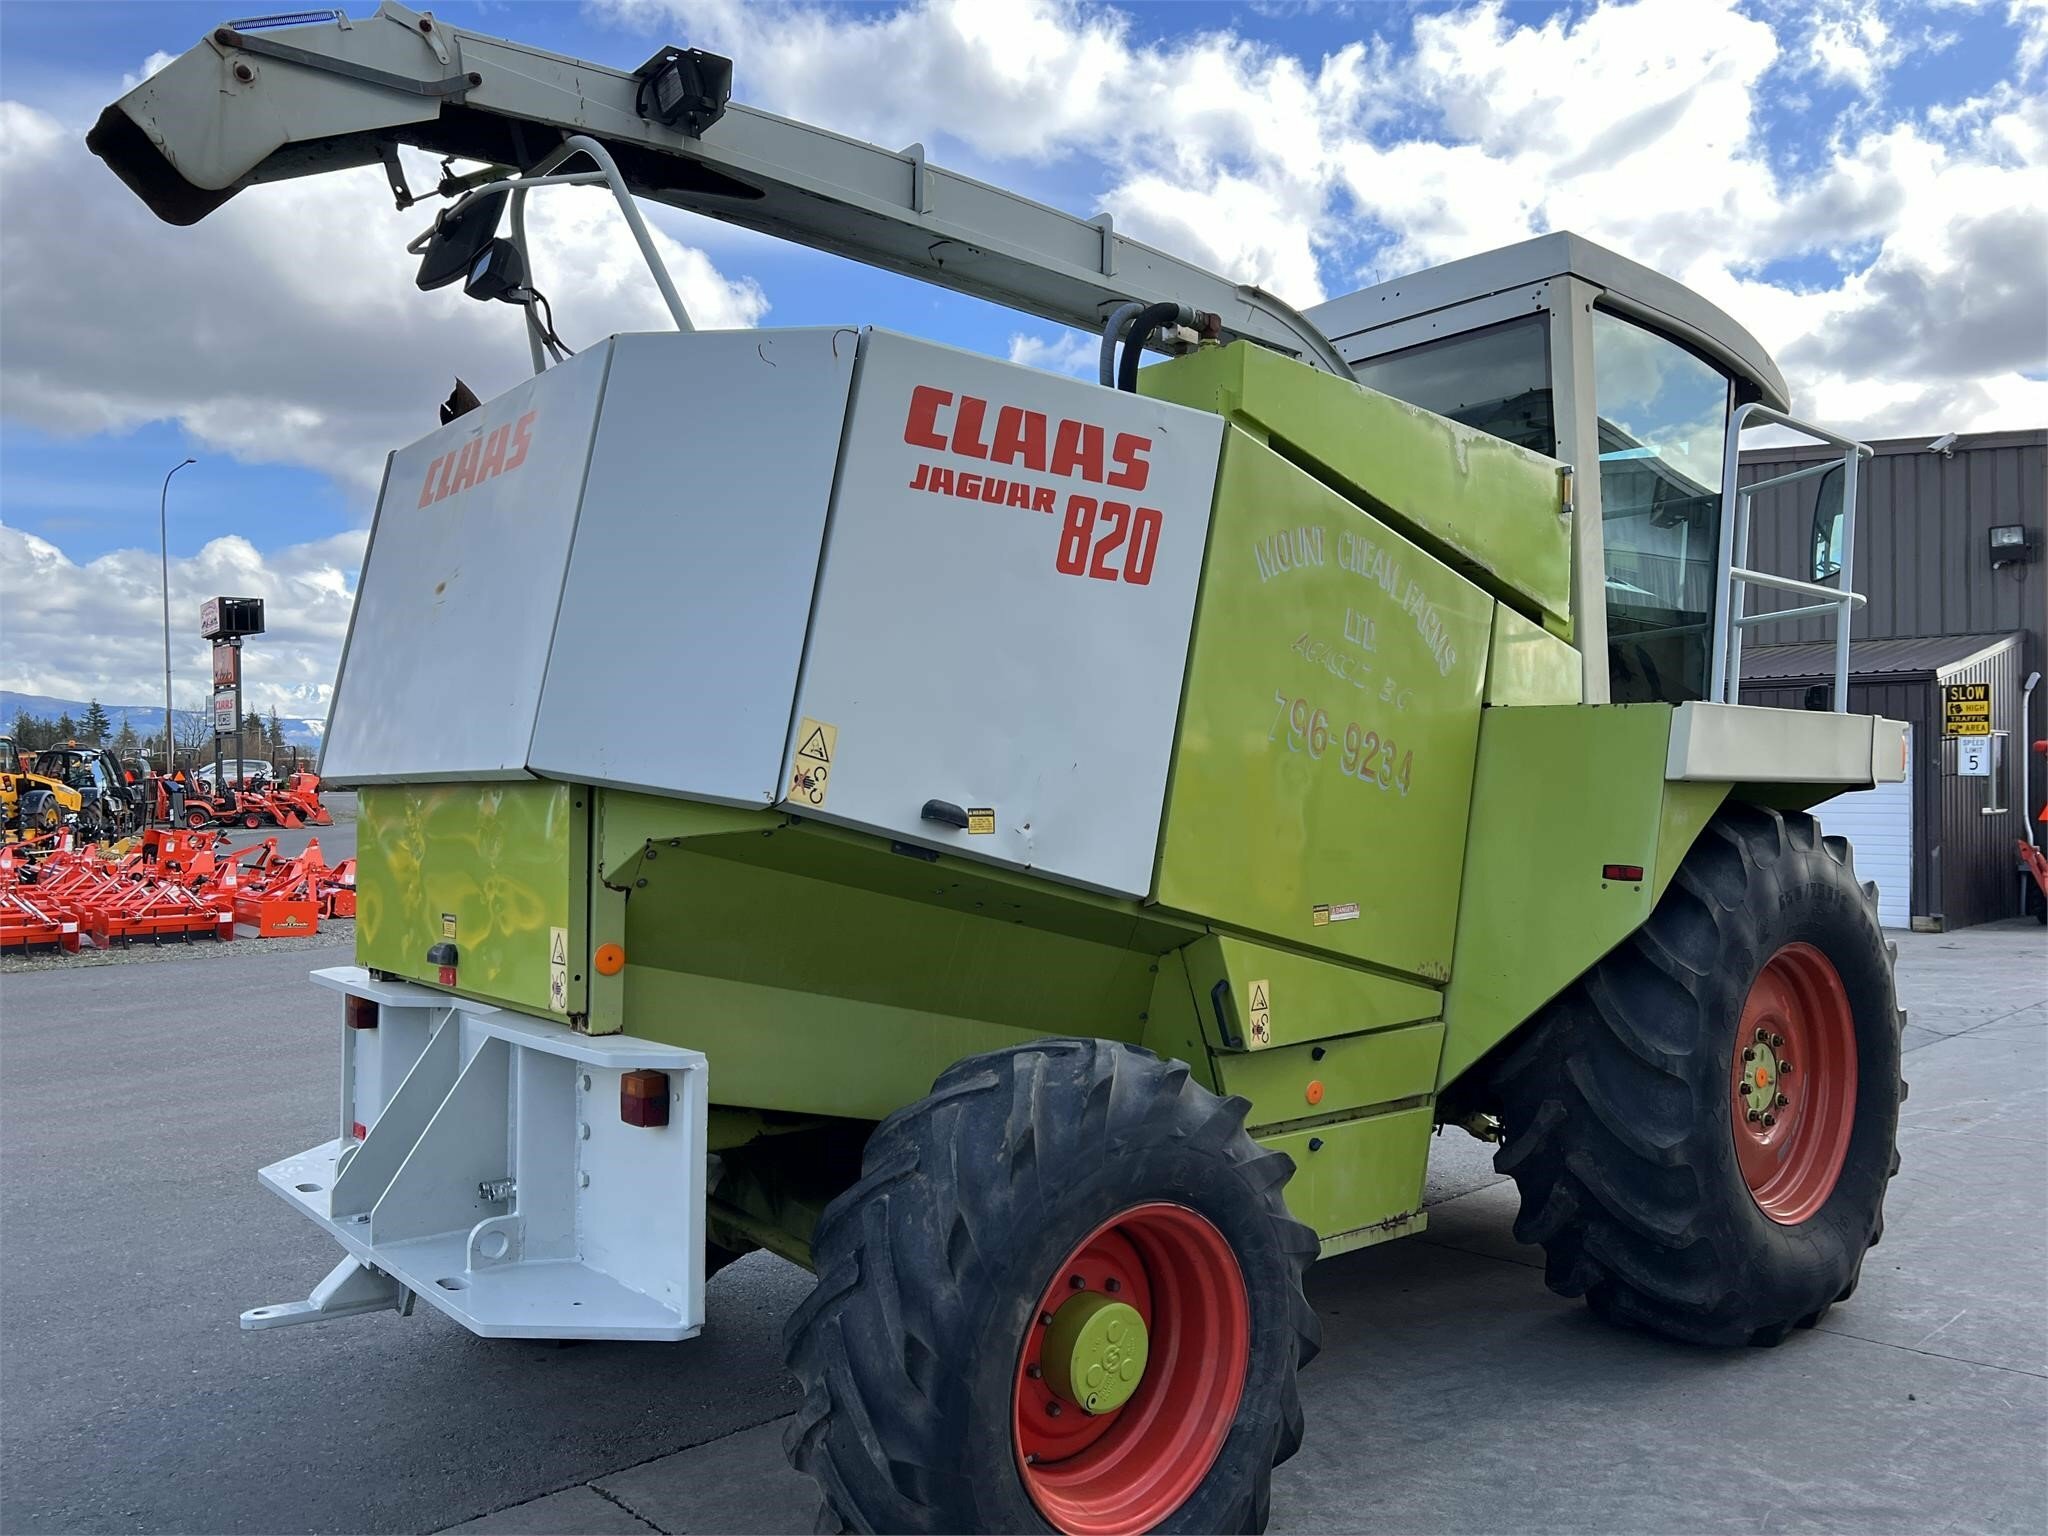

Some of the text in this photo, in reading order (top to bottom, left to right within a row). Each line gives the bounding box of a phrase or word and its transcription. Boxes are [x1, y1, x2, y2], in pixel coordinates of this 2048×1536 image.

[418, 410, 537, 510] CLAAS
[904, 385, 1153, 492] CLAAS
[909, 463, 1163, 586] JAGUAR 820
[1254, 524, 1326, 583] MOUNT
[1950, 686, 1985, 700] SLOW
[1965, 704, 1985, 712] HIGH
[1268, 688, 1414, 797] 796-9234
[1964, 724, 1986, 732] AREA
[1968, 755, 1979, 771] 5
